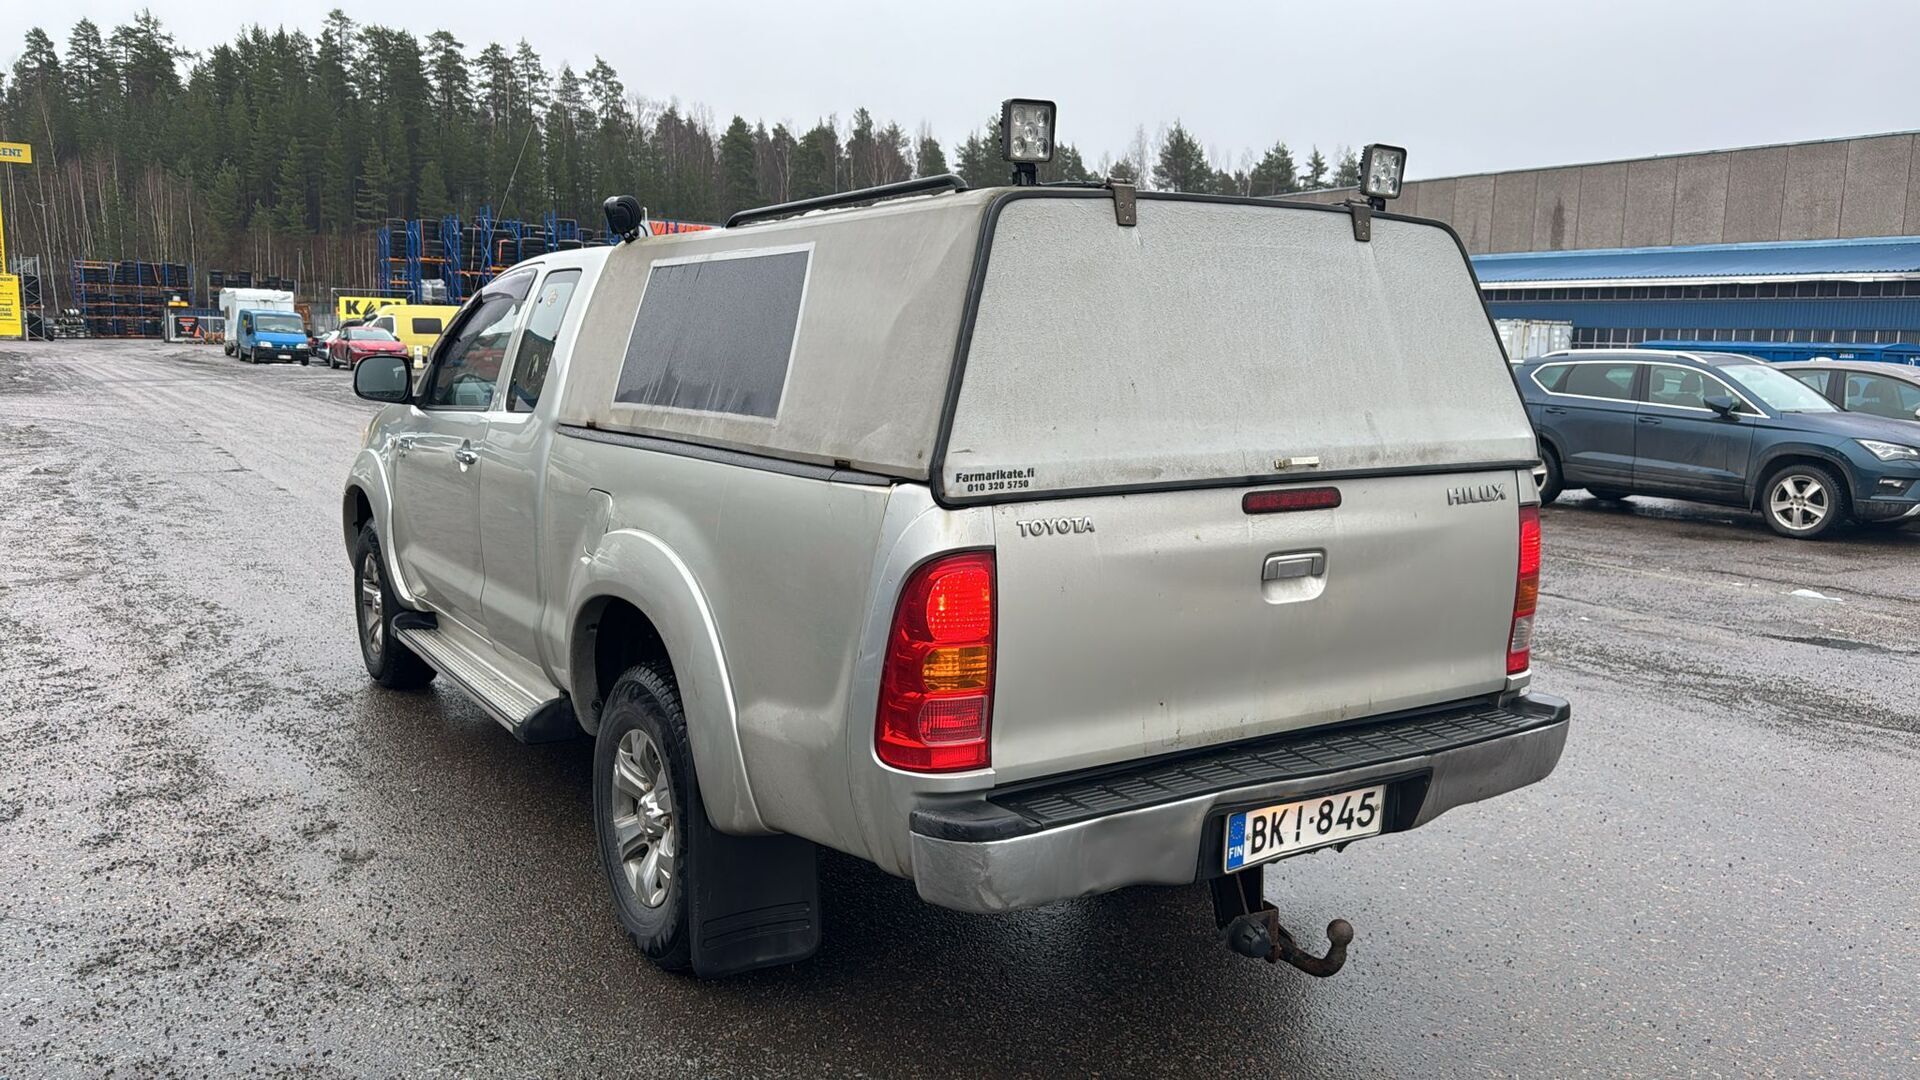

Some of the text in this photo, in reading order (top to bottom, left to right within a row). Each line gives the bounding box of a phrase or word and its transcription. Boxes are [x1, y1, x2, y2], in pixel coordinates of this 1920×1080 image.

[0, 148, 22, 157] ENT
[955, 468, 1034, 483] Farmarikate.fi
[967, 480, 1029, 492] 010 320 5750
[1447, 484, 1506, 506] HILUX
[1016, 516, 1095, 537] TOYOTA
[1228, 845, 1244, 860] FIN
